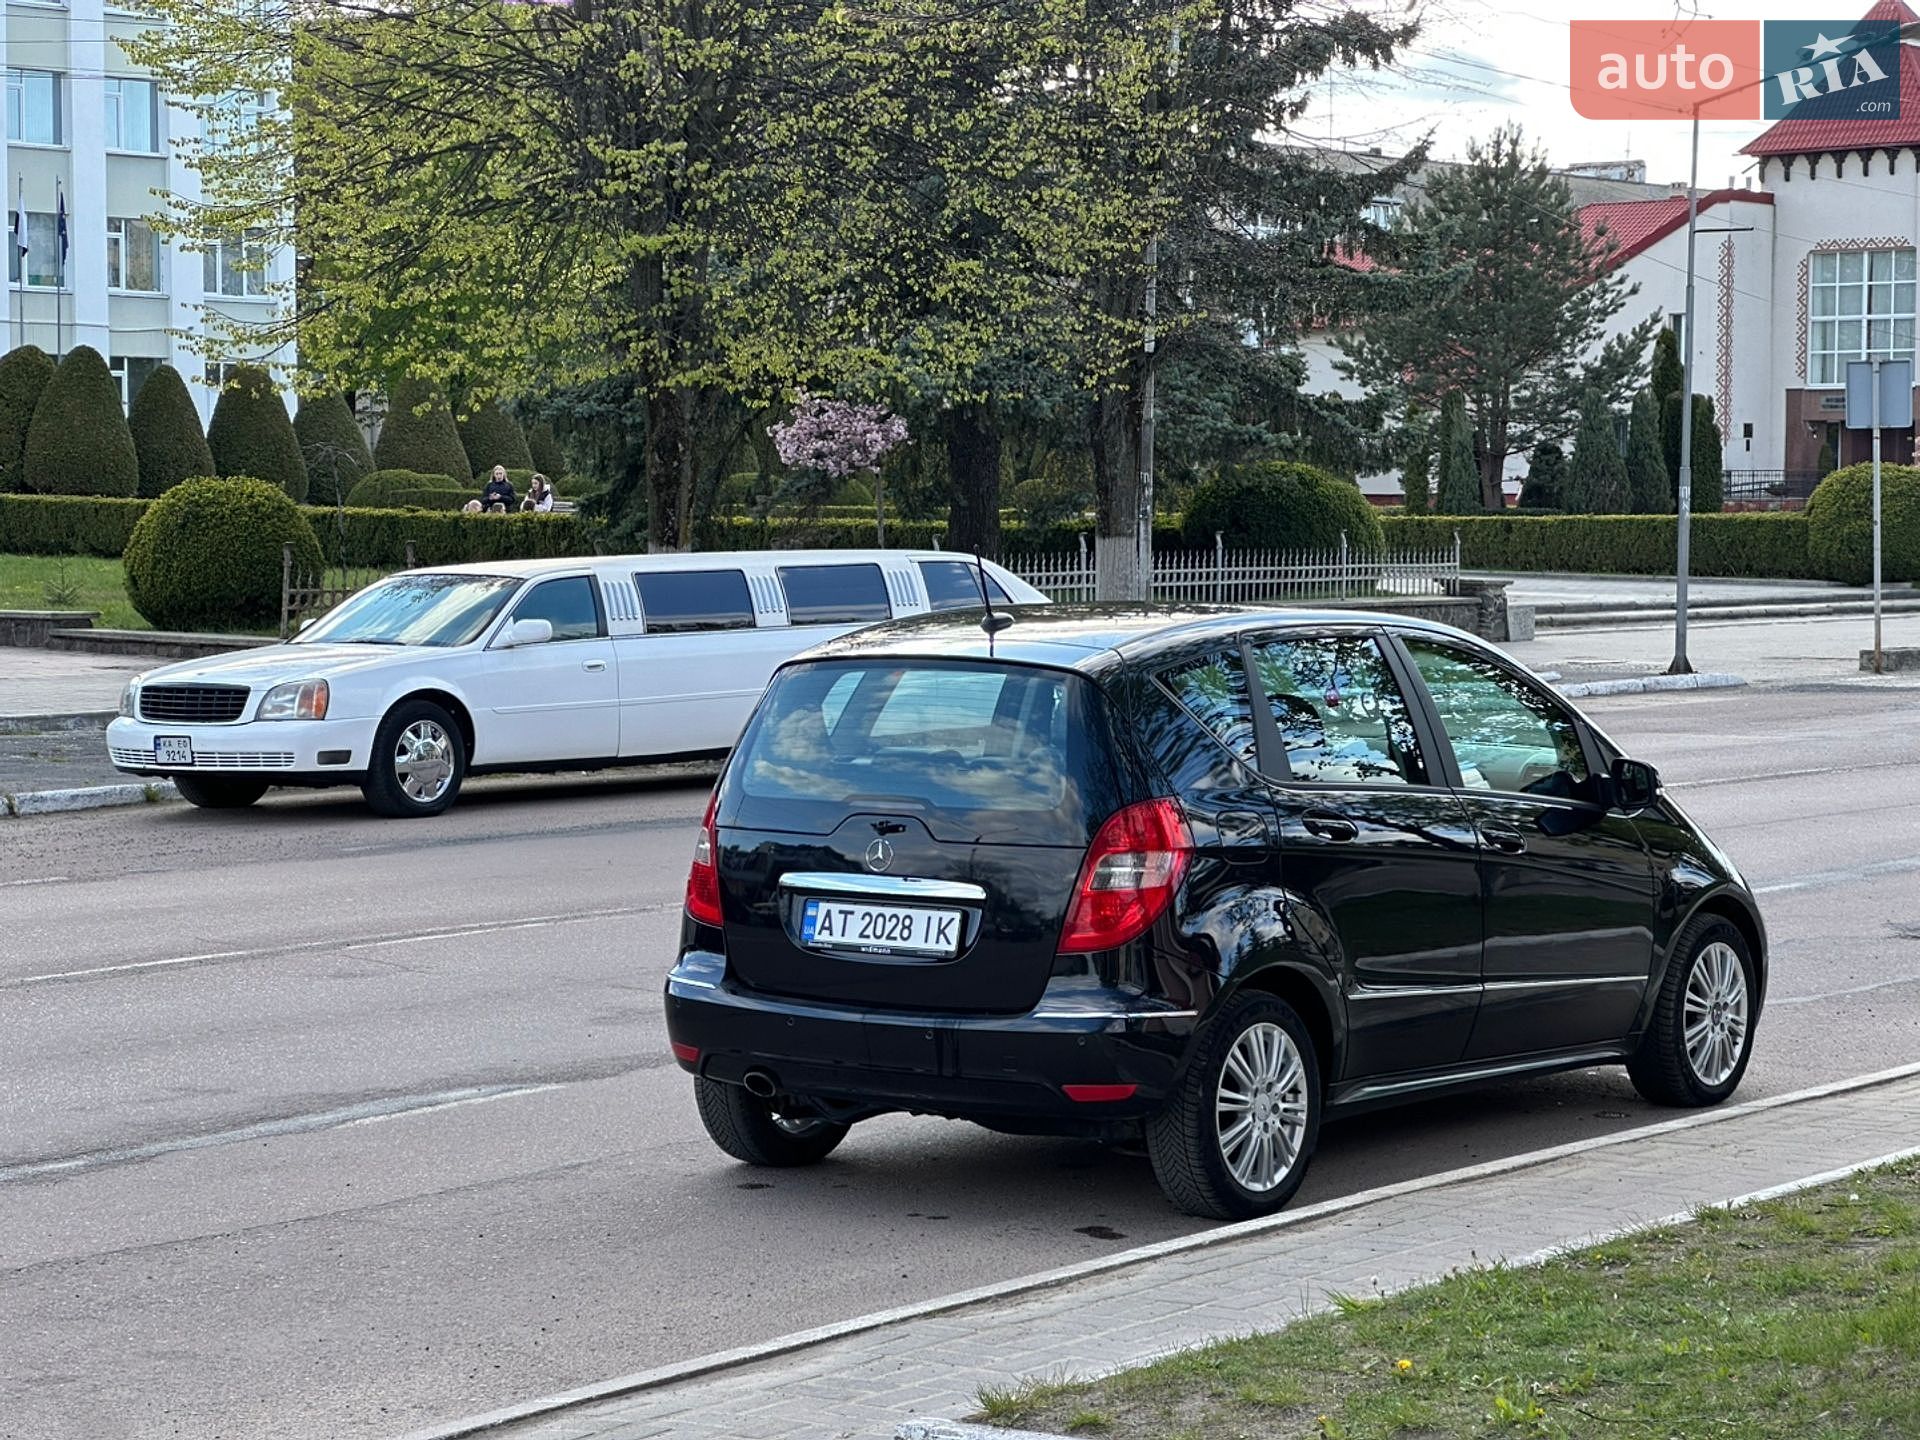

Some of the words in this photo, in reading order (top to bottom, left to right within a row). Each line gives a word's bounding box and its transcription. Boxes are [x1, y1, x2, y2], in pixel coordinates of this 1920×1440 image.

[817, 909, 855, 938] AT
[858, 912, 914, 941] 2028
[924, 915, 955, 946] IK
